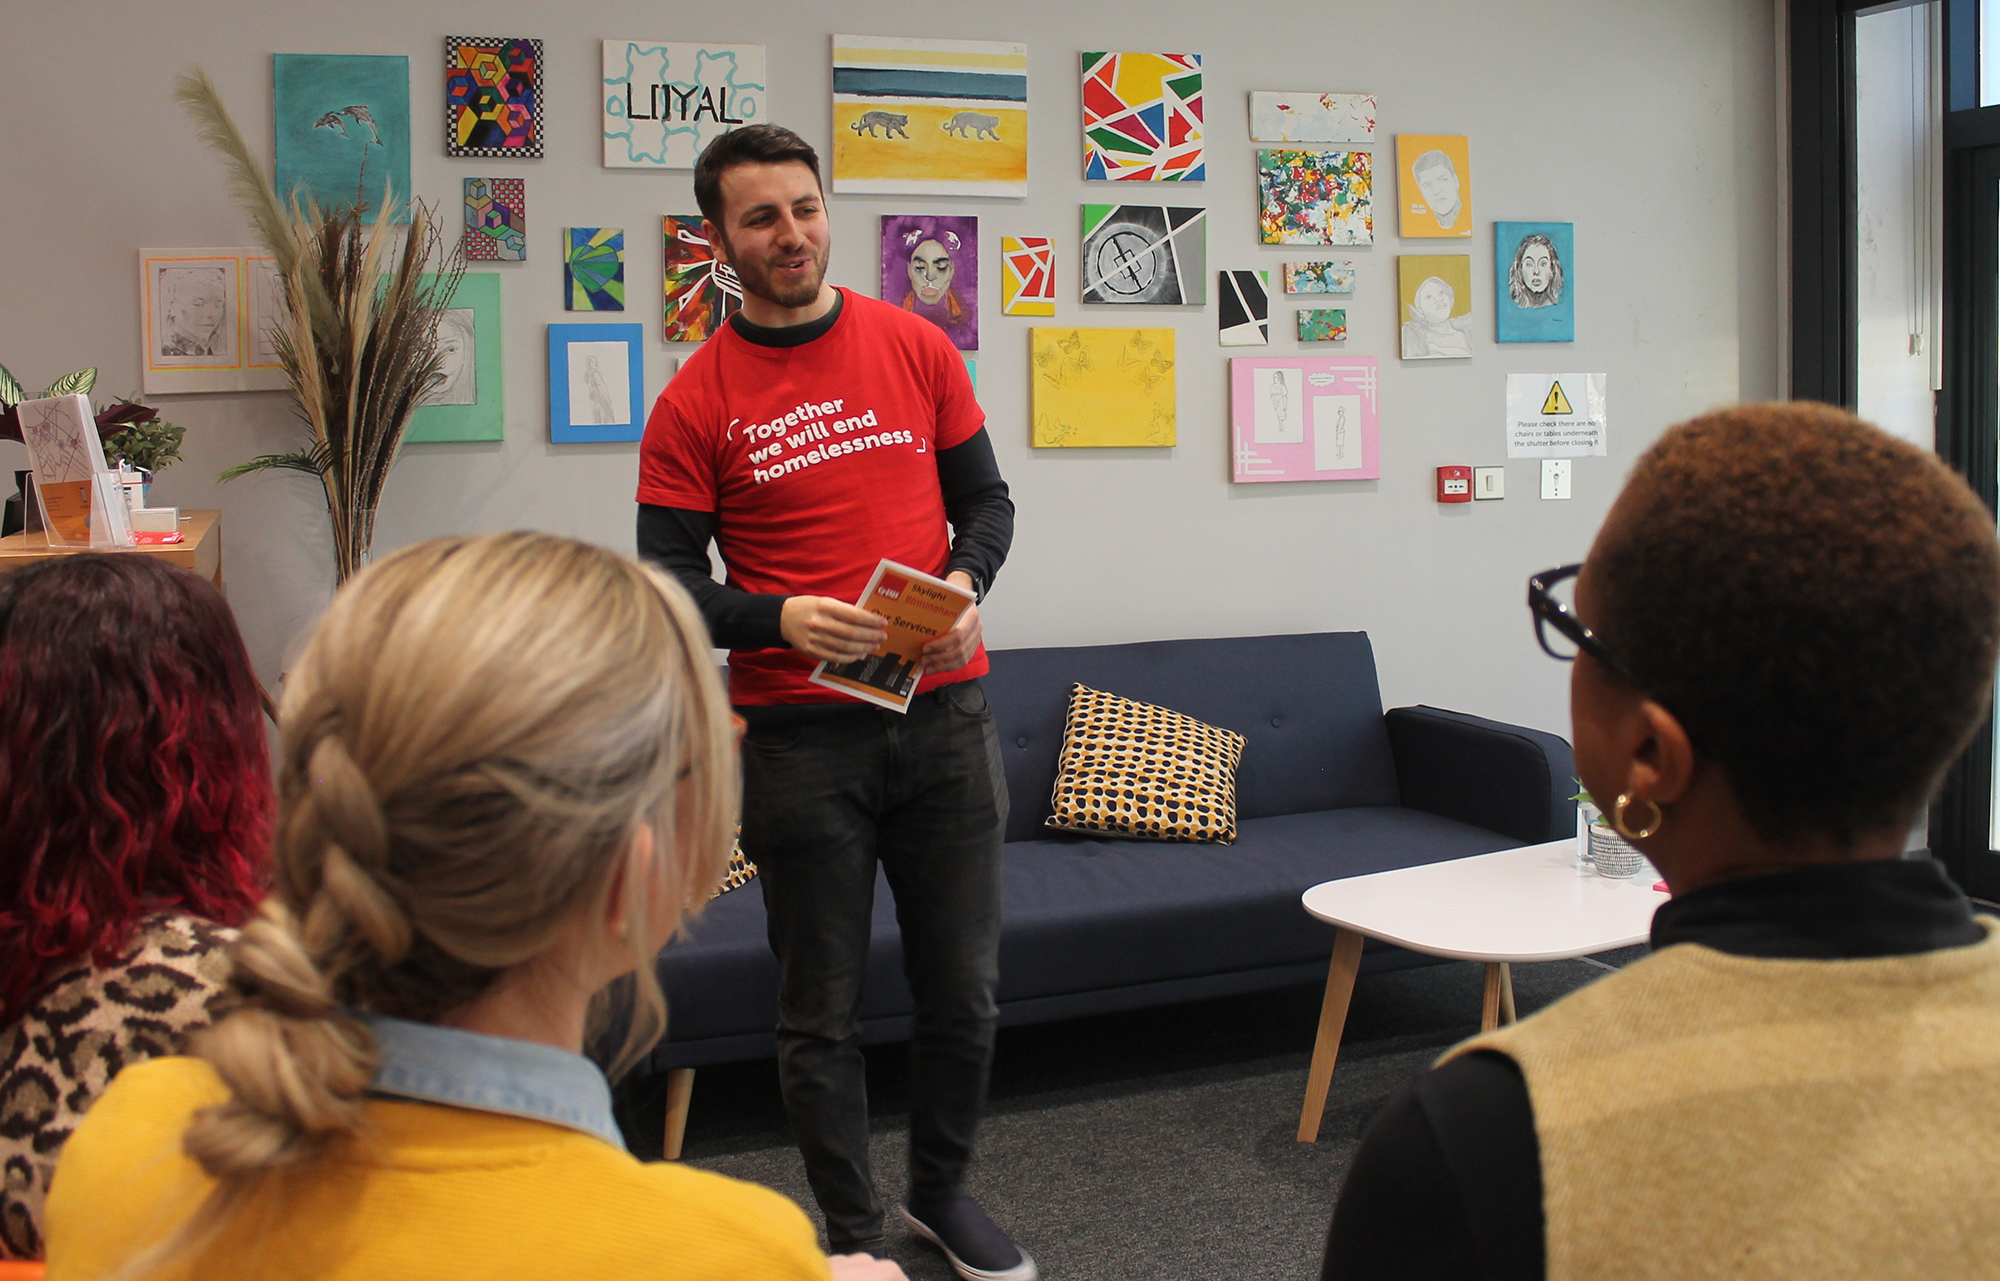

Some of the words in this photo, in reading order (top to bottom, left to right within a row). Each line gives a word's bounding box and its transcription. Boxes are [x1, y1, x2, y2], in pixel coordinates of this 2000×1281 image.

[626, 82, 743, 124] LOYAL
[742, 398, 844, 444] Together
[748, 442, 783, 465] we
[785, 420, 830, 450] will
[832, 409, 878, 434] end
[753, 429, 913, 484] homelessness
[1571, 439, 1593, 447] closing
[905, 595, 959, 619] Birmingham
[911, 583, 947, 602] Skylight
[893, 616, 938, 637] Services
